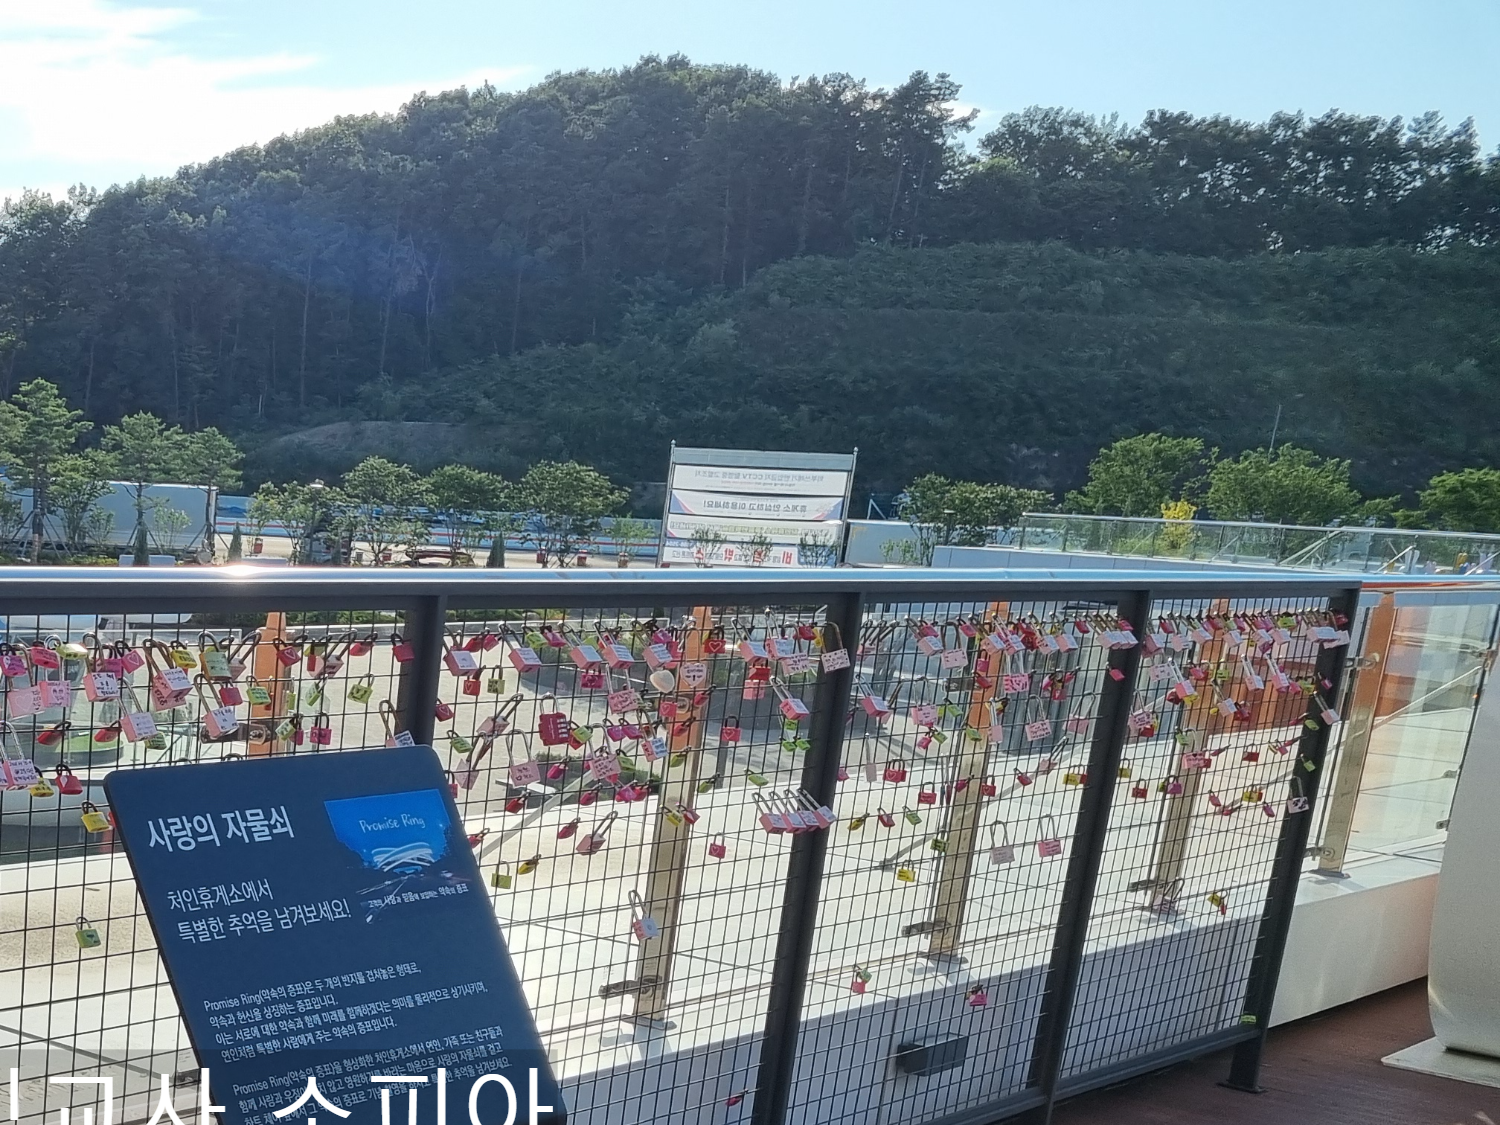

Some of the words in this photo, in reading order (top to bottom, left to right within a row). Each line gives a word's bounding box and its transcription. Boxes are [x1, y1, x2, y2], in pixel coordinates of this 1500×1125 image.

[147, 813, 221, 852] 사랑의
[221, 805, 295, 843] 자물쇠
[359, 817, 400, 833] Promise
[401, 813, 425, 828] Ring
[167, 878, 274, 912] 처인휴게소에서
[384, 894, 402, 905] 사랑과
[438, 886, 456, 896] 약속의
[456, 883, 469, 893] 증표
[177, 916, 227, 944] 특별한
[227, 910, 275, 937] 추억을
[274, 898, 352, 929] 남겨보세요!
[203, 996, 240, 1012] Promise
[240, 986, 288, 1004] Ring(약속의
[287, 980, 315, 998] 증표)은
[315, 979, 324, 991] 두
[324, 975, 342, 989] 개의
[341, 970, 366, 987] 반지를
[365, 965, 397, 983] 겹쳐놓은
[395, 961, 422, 977] 형태로,
[209, 1014, 237, 1029] 약속과
[236, 1007, 263, 1024] 헌신을
[263, 1002, 296, 1020] 상징하는
[296, 993, 339, 1013] 증표입니다.
[215, 1032, 234, 1046] 이는
[235, 1025, 261, 1041] 서로에
[260, 1022, 279, 1036] 대한
[278, 1017, 304, 1032] 약속과
[304, 1013, 323, 1029] 함께
[322, 1008, 347, 1024] 미래를
[345, 1001, 392, 1020] 함께하겠다는
[391, 995, 415, 1010] 의미를
[414, 988, 451, 1006] 물리적으로
[220, 1046, 256, 1063] 연인처럼
[255, 1039, 282, 1055] 특별한
[282, 1032, 315, 1049] 사람에게
[314, 1029, 333, 1043] 주는
[332, 1024, 358, 1039] 약속의
[357, 1015, 398, 1035] 증표입니다.
[232, 1080, 269, 1096] Promise
[268, 1067, 315, 1087] Ring(약속의
[315, 1061, 343, 1078] 증표)을
[342, 1053, 375, 1072] 형상화한
[374, 1042, 426, 1063] 처인휴게소에서
[425, 1039, 445, 1052] 연인,
[444, 1035, 460, 1049] 가족
[459, 1033, 475, 1045] 또는
[474, 1025, 504, 1042] 친구들과
[238, 1100, 258, 1114] 함께
[258, 1091, 284, 1108] 사랑과
[326, 1078, 345, 1094] 않고
[406, 1057, 438, 1073] 마음으로
[437, 1052, 461, 1068] 사랑의
[460, 1045, 488, 1061] 자물쇠를
[487, 1042, 503, 1055] 걸고
[307, 1102, 318, 1115] 그
[342, 1092, 368, 1107] 증표로
[430, 1069, 454, 1084] 특한
[453, 1064, 476, 1080] 추억을
